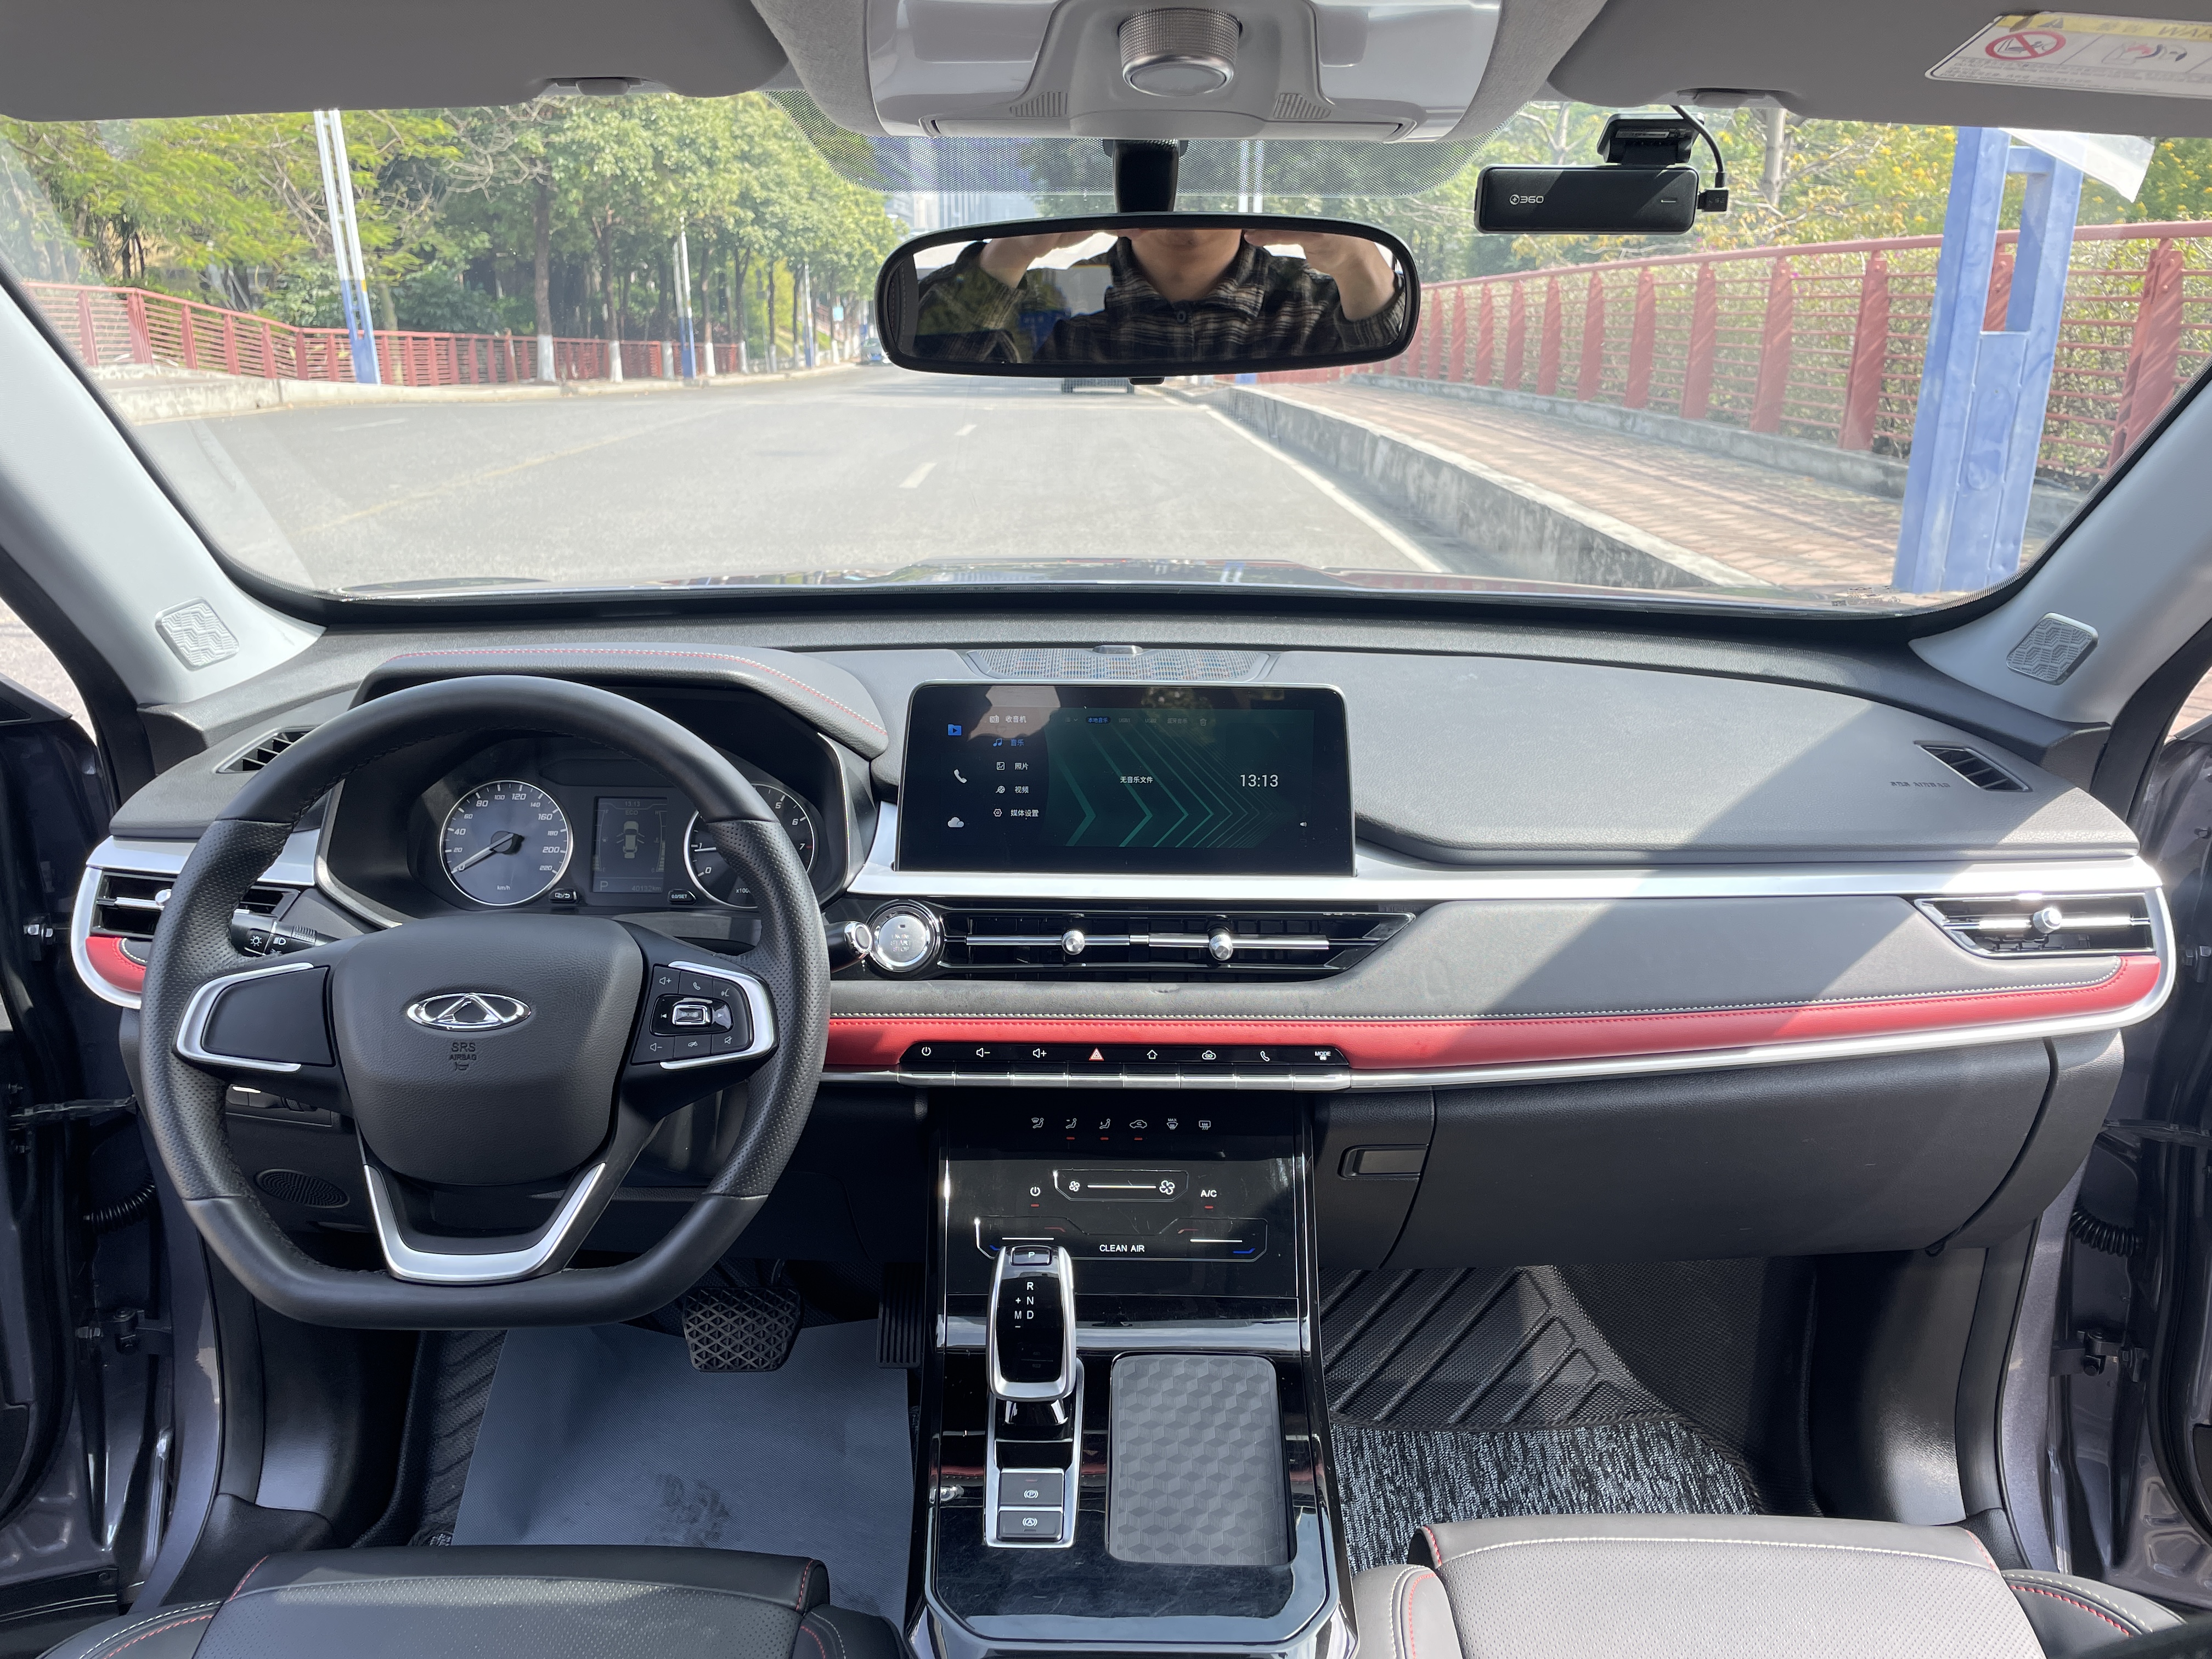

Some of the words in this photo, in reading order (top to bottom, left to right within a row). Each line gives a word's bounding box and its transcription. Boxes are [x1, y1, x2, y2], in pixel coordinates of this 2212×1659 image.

[1520, 195, 1544, 204] 360
[1005, 715, 1026, 723] 收音机
[1240, 774, 1278, 787] 13:13
[600, 881, 608, 891] P
[451, 1042, 476, 1052] SRS
[1200, 1189, 1217, 1198] A/C
[1099, 1244, 1127, 1253] CLEAN
[1131, 1244, 1145, 1253] AIR
[1027, 1282, 1034, 1290] R
[1027, 1296, 1034, 1305] N
[1014, 1311, 1022, 1319] M
[1027, 1311, 1034, 1319] D
